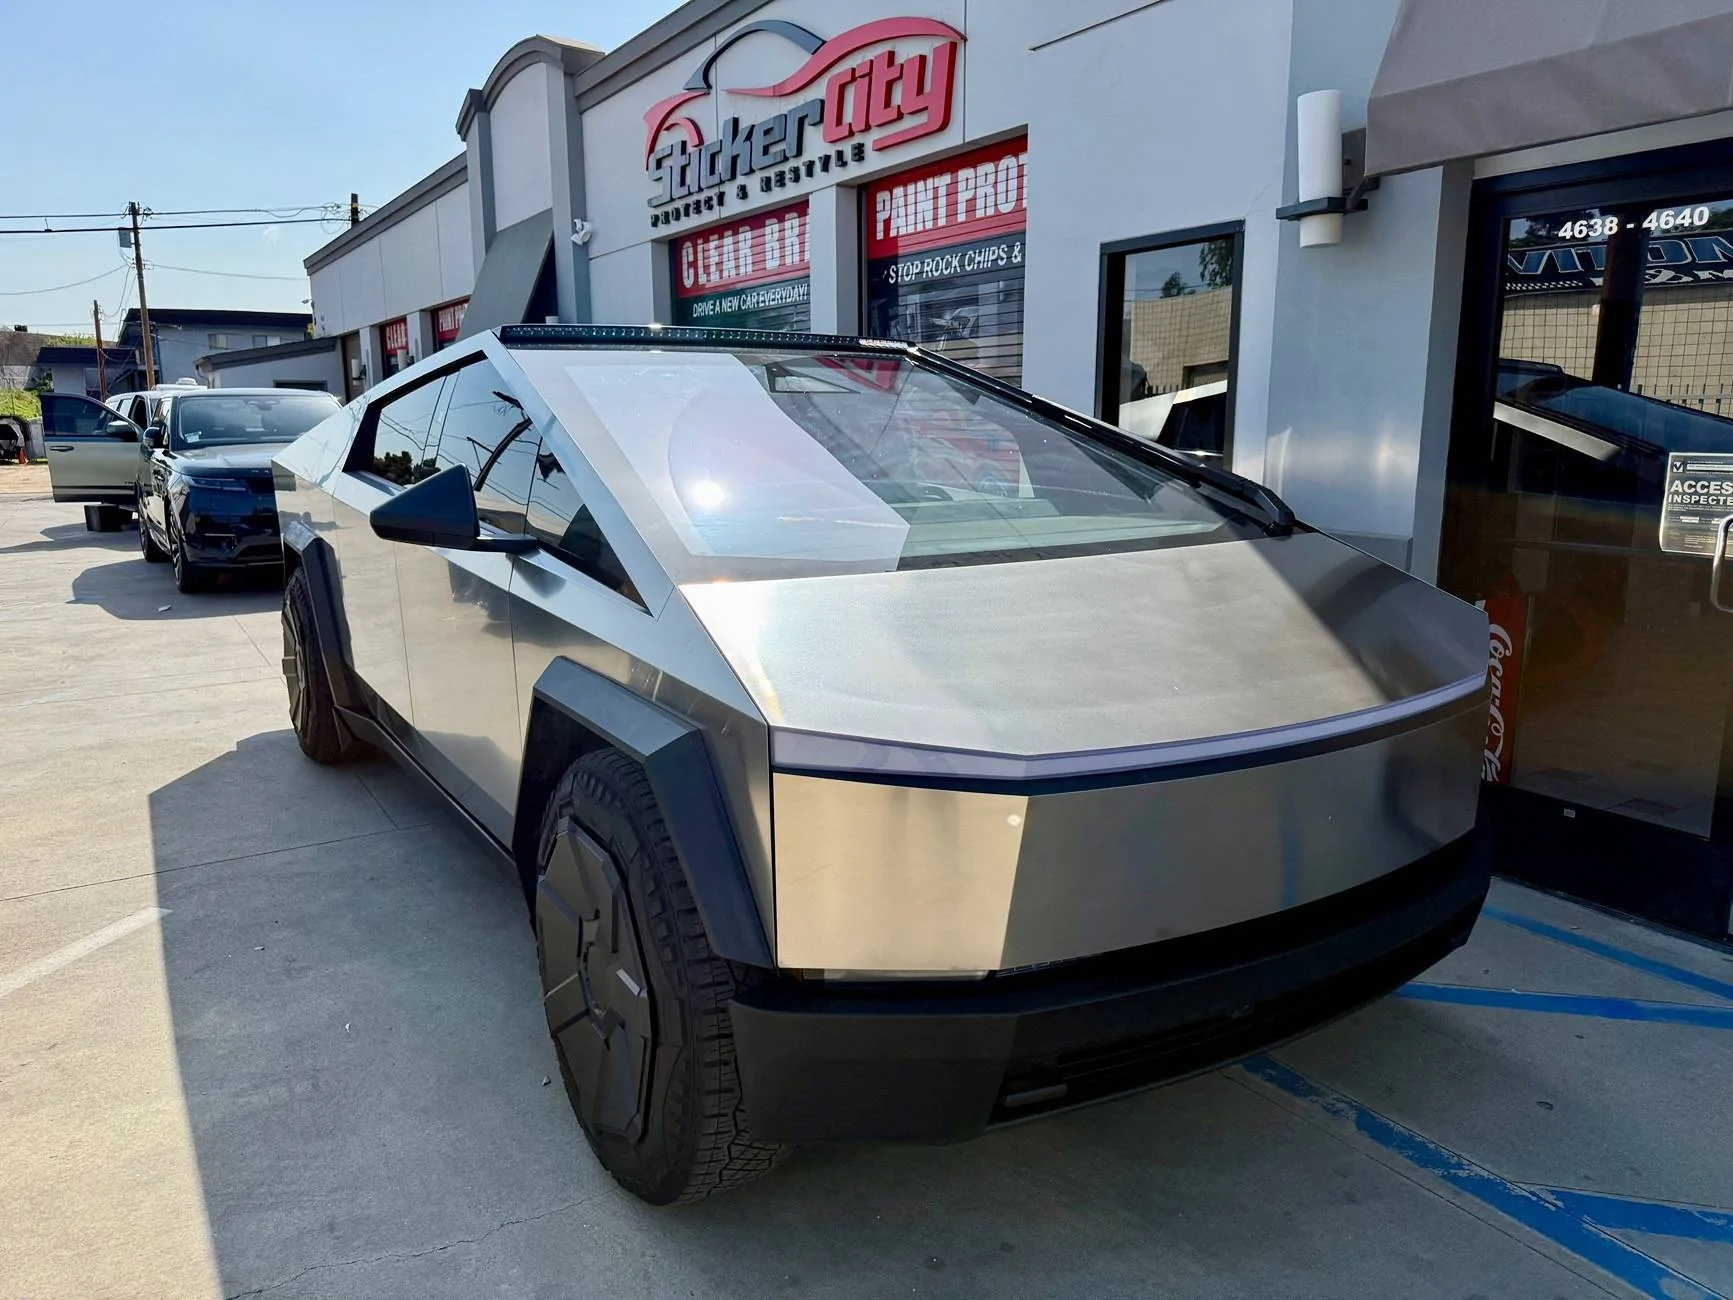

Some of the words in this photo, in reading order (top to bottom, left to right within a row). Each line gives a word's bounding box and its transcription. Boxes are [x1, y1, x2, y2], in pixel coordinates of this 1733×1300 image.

[647, 99, 825, 208] Sticker
[823, 41, 957, 152] City
[651, 191, 726, 228] PROTECT
[736, 184, 749, 200] &
[760, 143, 865, 193] RESTYLE
[876, 172, 952, 240] PAINT
[1558, 216, 1619, 240] 4638
[1642, 206, 1710, 231] 4640
[682, 226, 753, 288] CLEAR
[888, 262, 922, 284] STOP
[923, 252, 961, 279] ROCK
[965, 244, 1008, 272] CHIPS
[1012, 241, 1022, 264] &
[693, 301, 715, 317] DRIVE
[715, 301, 721, 313] A
[722, 295, 740, 313] NEW
[741, 294, 758, 309] CAR
[759, 283, 808, 306] EVERYDAY!
